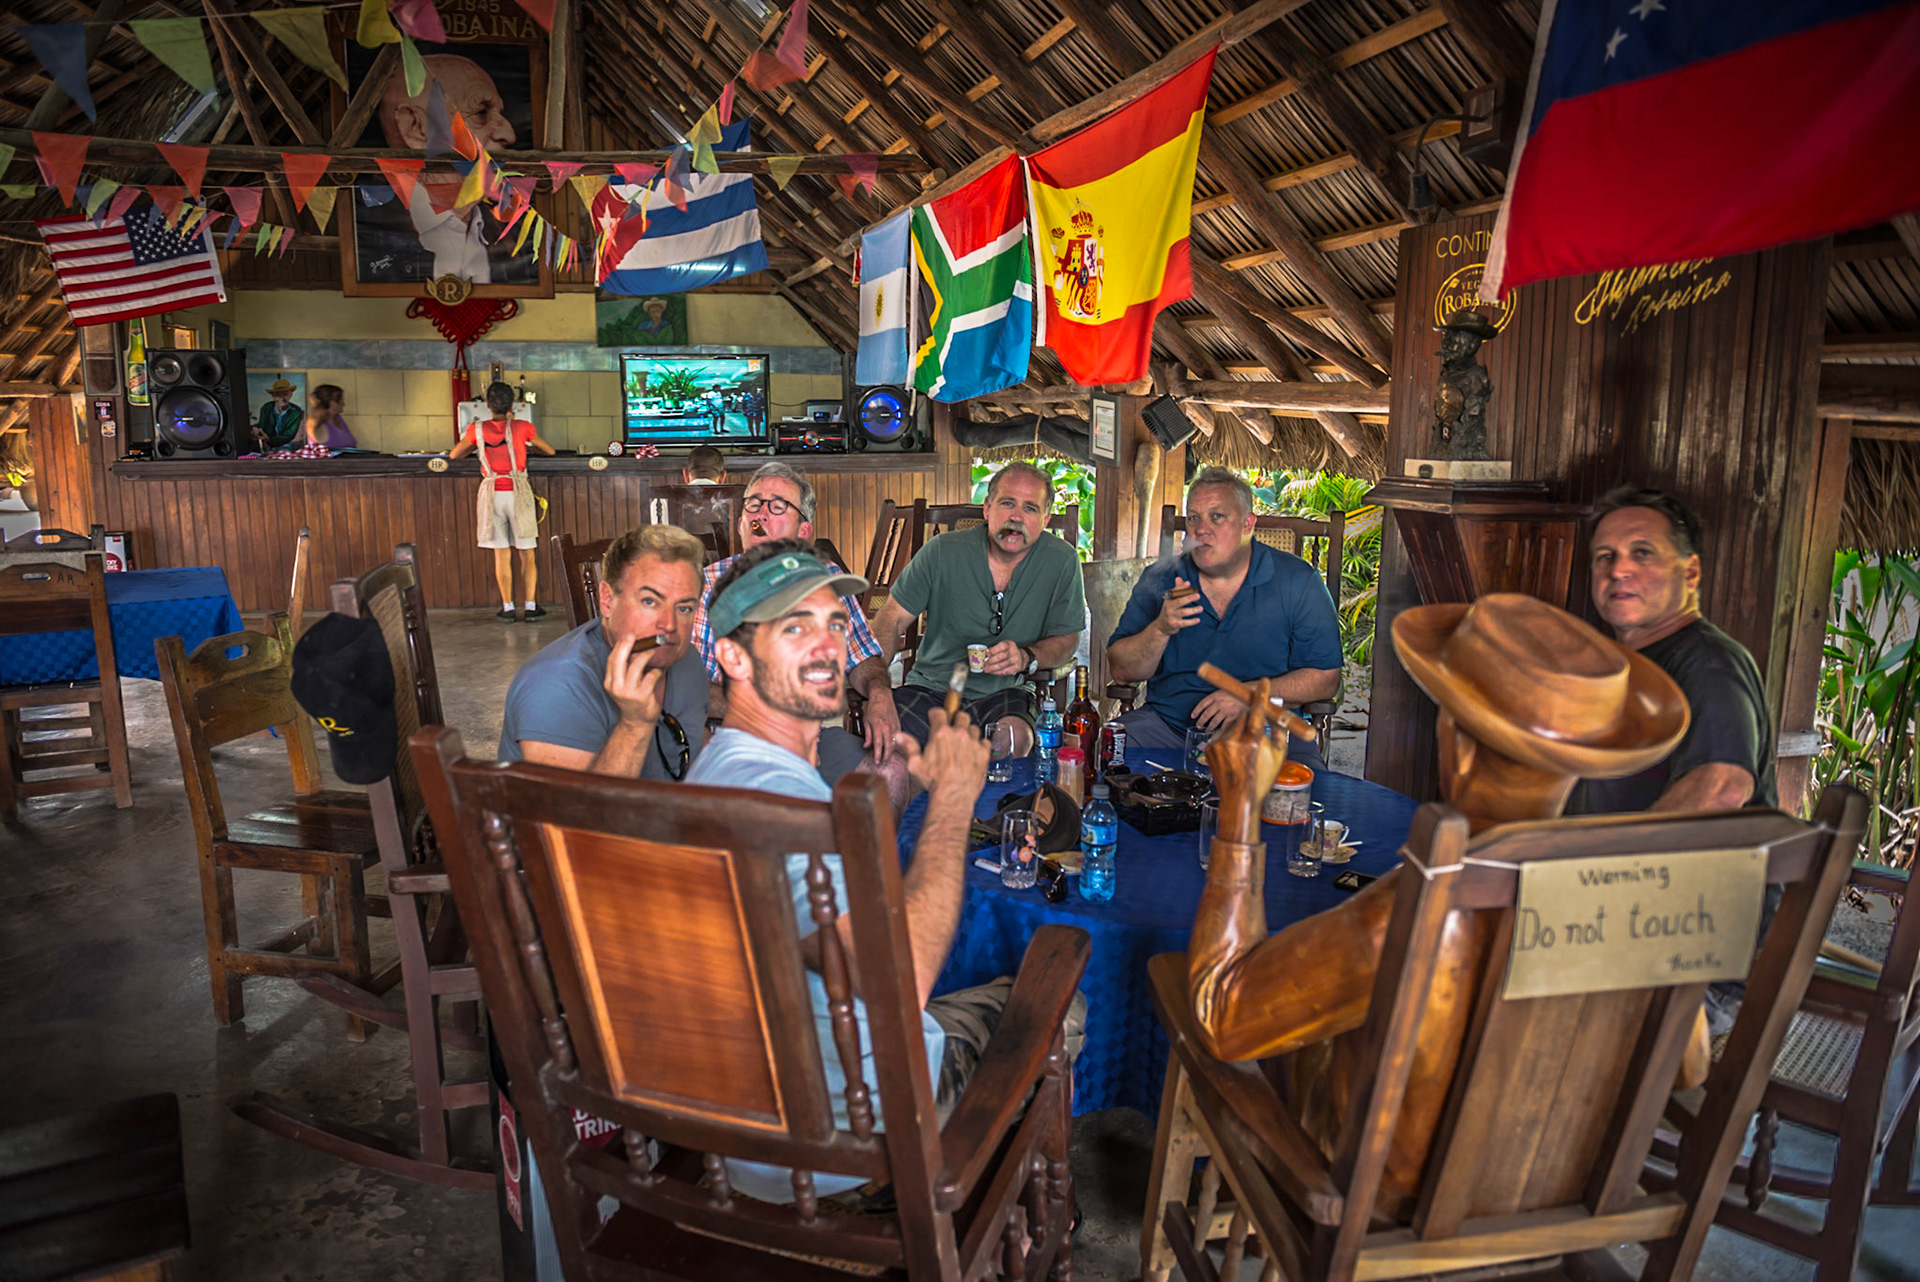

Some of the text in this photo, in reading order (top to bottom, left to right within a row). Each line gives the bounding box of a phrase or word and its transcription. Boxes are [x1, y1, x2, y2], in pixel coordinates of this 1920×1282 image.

[457, 0, 500, 13] 1845
[441, 13, 538, 38] OBAINA
[1436, 230, 1492, 258] CONTIN
[443, 282, 458, 300] R
[1461, 280, 1480, 291] VEG
[431, 461, 444, 469] HR
[592, 459, 605, 467] HR
[1518, 893, 1716, 951] Do not touch
[573, 1117, 622, 1141] TRIK
